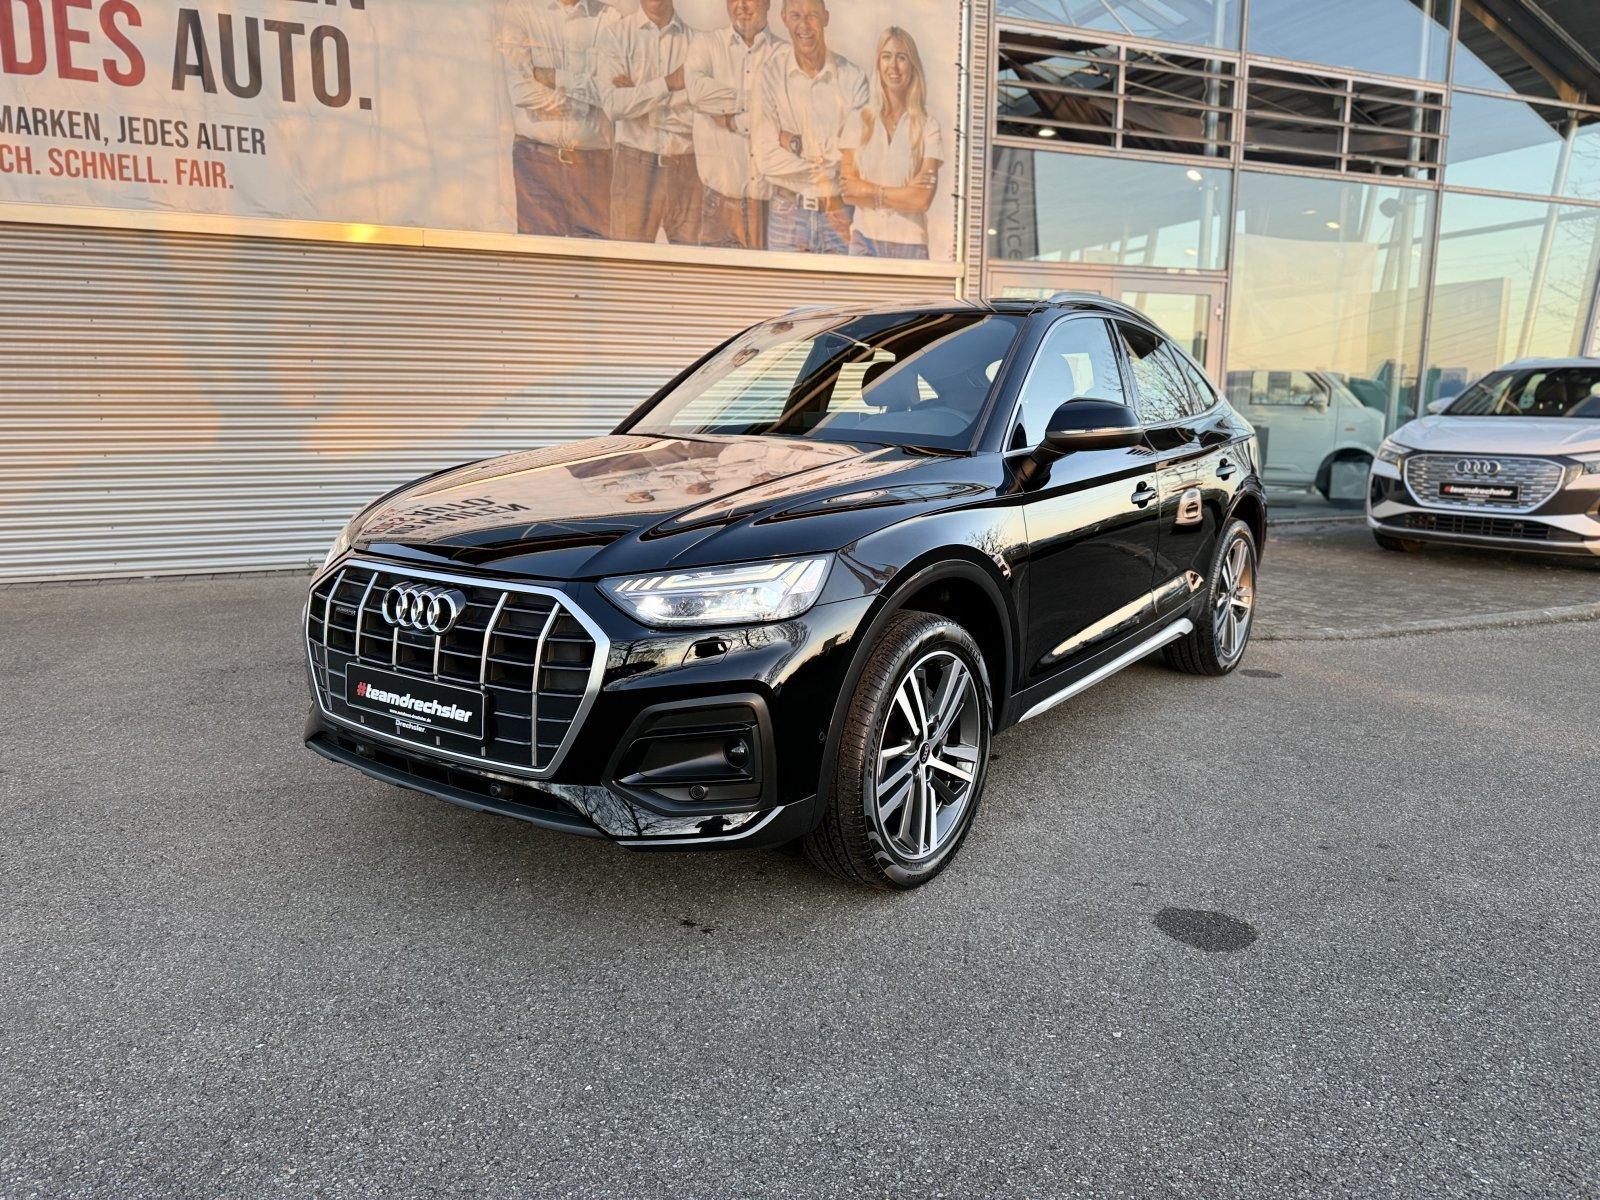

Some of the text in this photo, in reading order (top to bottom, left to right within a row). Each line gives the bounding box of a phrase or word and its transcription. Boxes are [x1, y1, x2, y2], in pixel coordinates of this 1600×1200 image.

[0, 0, 373, 110] DES AUTO.
[117, 116, 189, 149] JEDES
[197, 123, 266, 155] ALTER
[48, 147, 168, 184] SCHNELL.
[175, 158, 234, 189] FAIR.
[356, 681, 473, 723] #teamdrechsler
